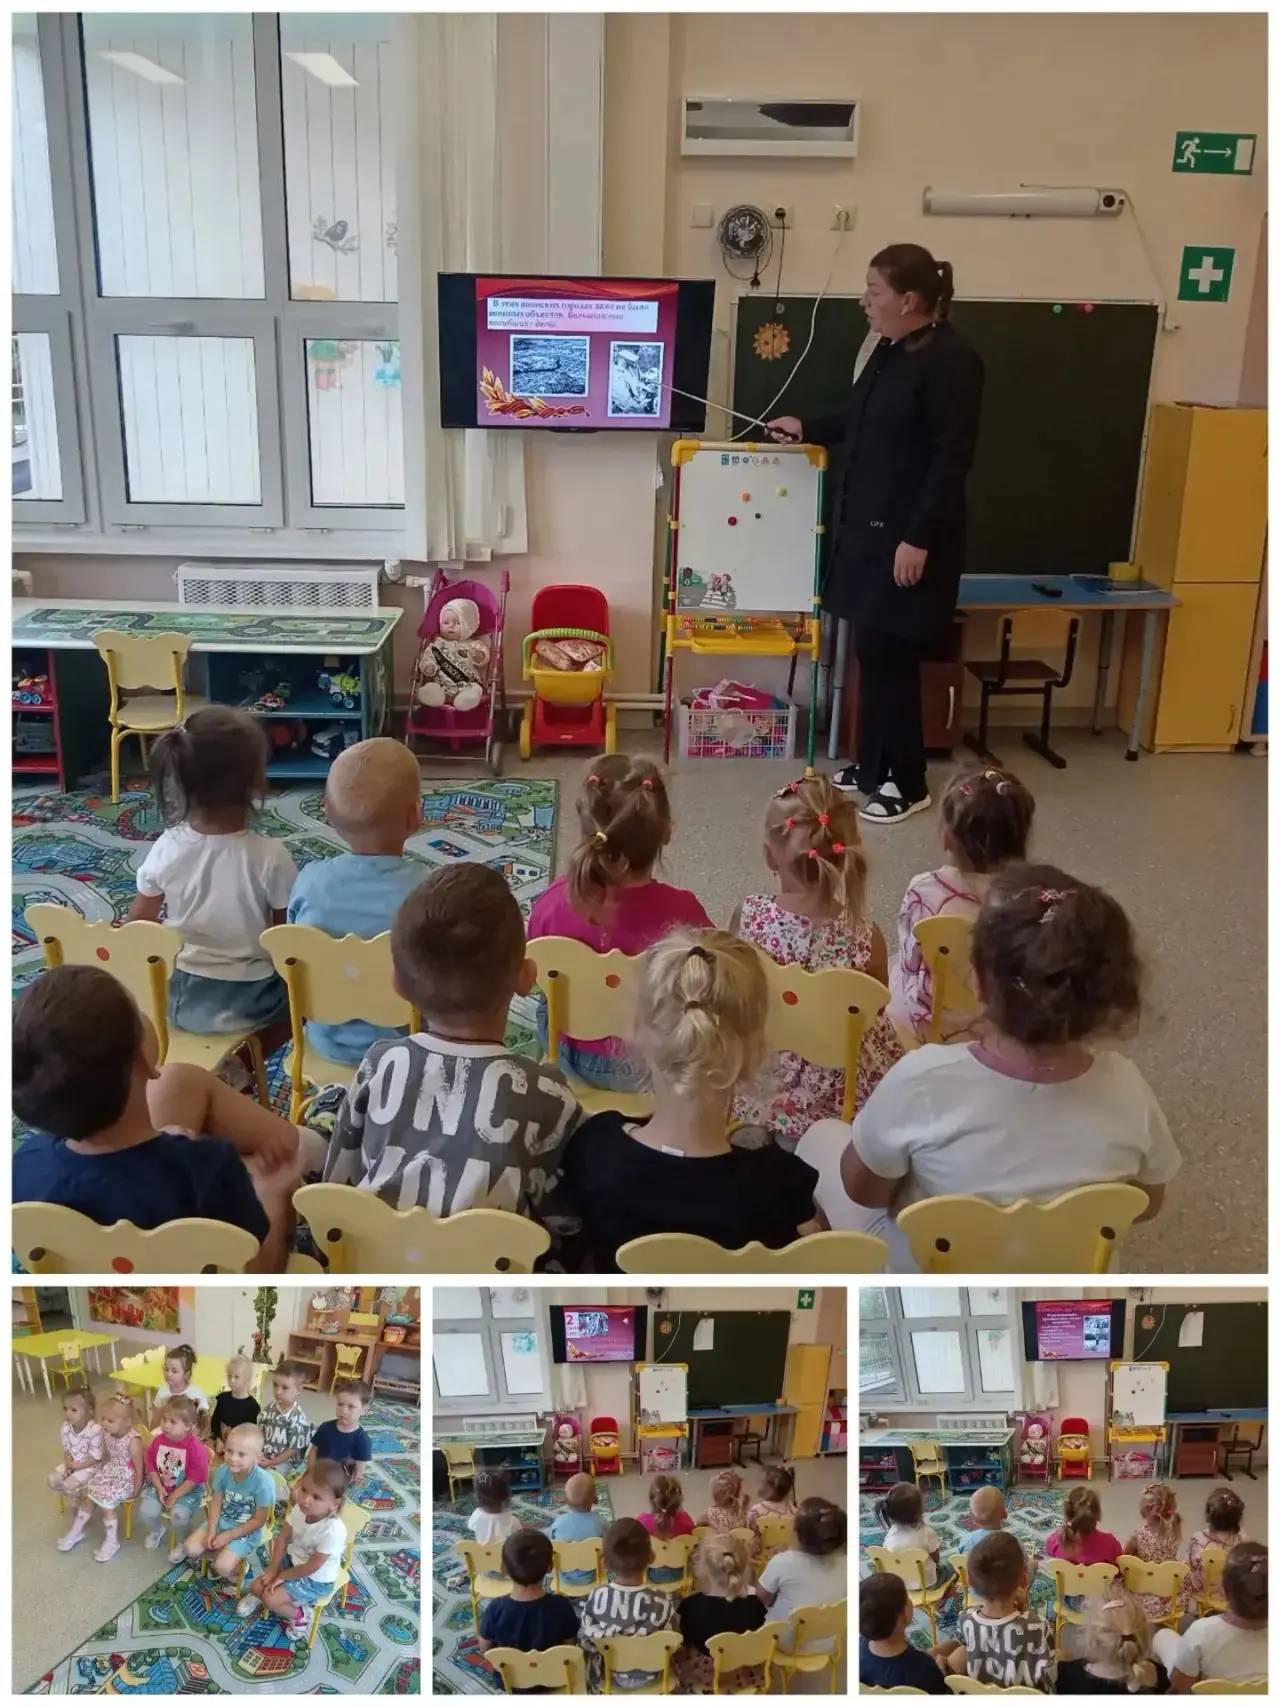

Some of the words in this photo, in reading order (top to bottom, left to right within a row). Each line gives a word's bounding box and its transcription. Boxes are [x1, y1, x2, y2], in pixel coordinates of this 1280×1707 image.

[493, 299, 499, 307] В
[520, 301, 560, 309] японских
[561, 302, 593, 311] городах
[566, 1314, 574, 1325] 2
